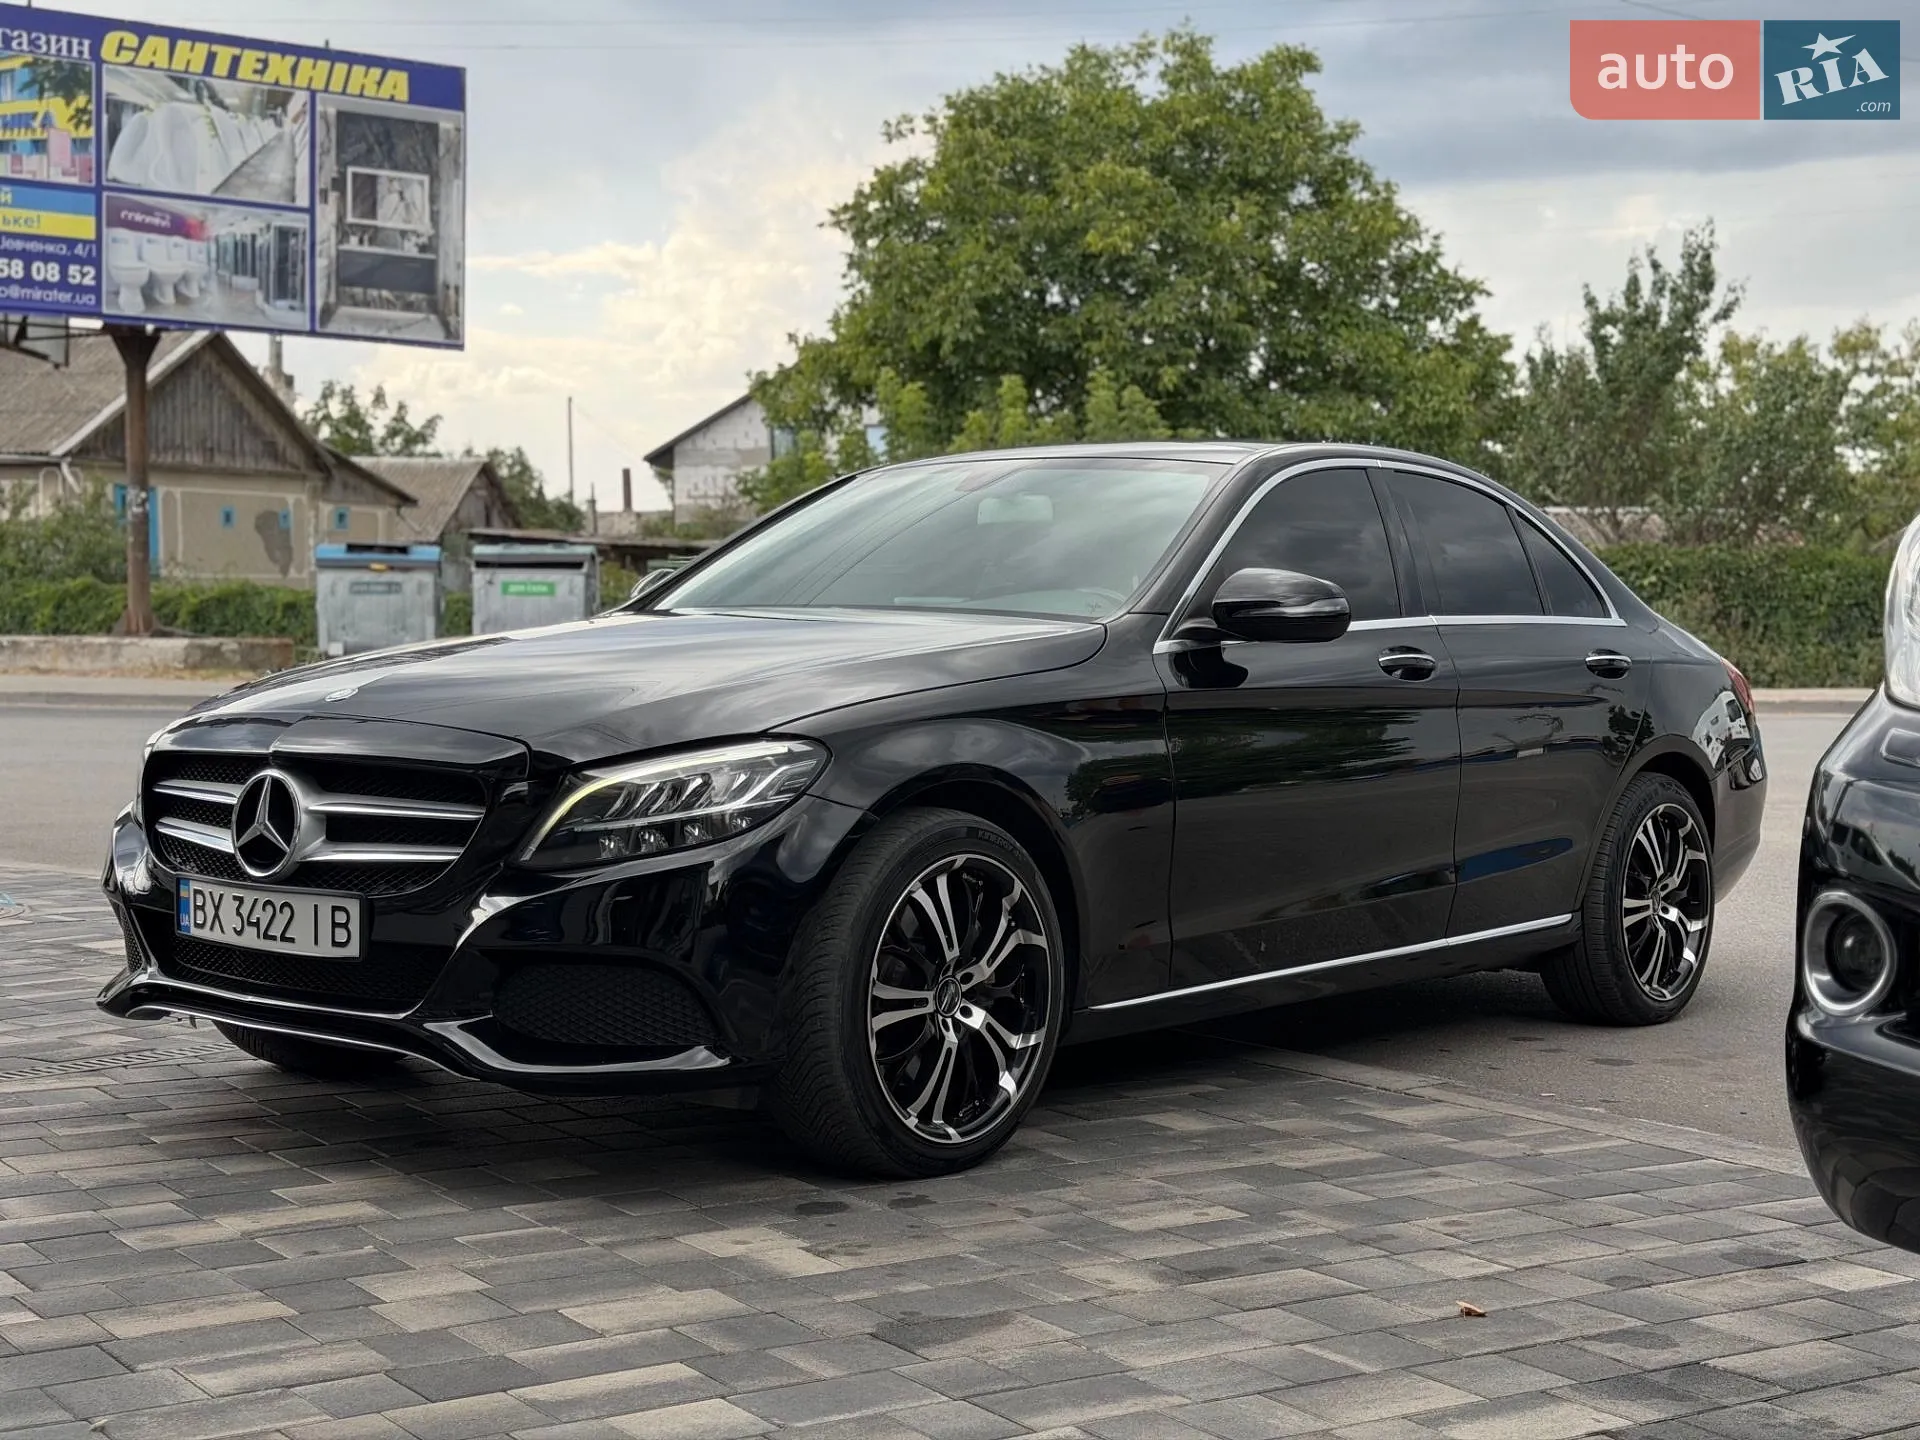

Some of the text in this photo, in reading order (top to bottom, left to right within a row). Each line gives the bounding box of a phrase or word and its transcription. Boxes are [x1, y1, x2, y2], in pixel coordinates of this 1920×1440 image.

[100, 30, 409, 101] САНТЕХНІКА
[74, 242, 97, 259] 4/1
[31, 260, 61, 283] 08
[67, 263, 97, 286] 52
[193, 888, 352, 948] BX 3422 IB
